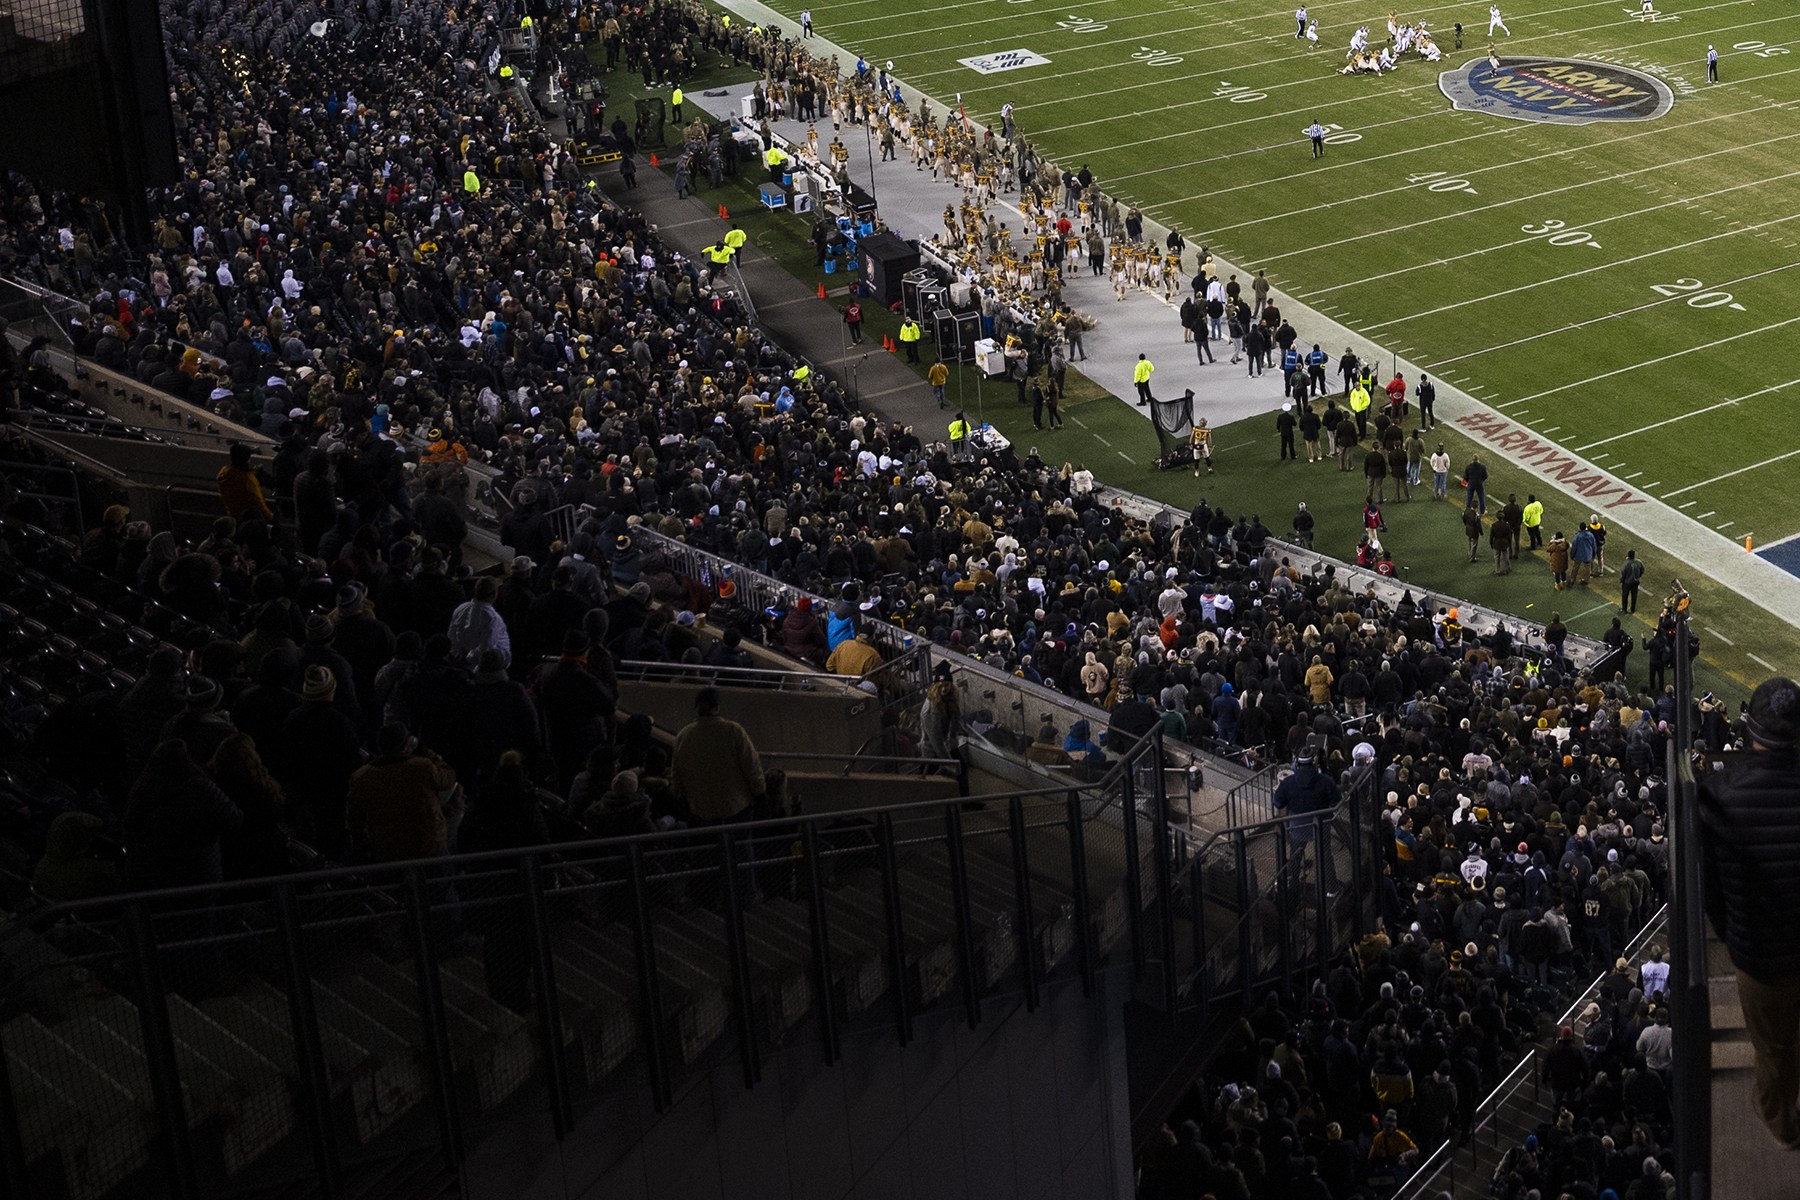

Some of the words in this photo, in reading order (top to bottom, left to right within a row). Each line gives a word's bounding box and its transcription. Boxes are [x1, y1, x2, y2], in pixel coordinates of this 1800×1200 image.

[1056, 17, 1108, 33] 20
[1131, 49, 1184, 66] 30
[1732, 40, 1790, 58] 50
[1480, 74, 1592, 110] NAVY
[1530, 64, 1651, 98] ARMY
[1212, 86, 1267, 103] 40
[1406, 170, 1470, 193] 40
[1522, 219, 1594, 246] 30
[1650, 277, 1733, 309] 20
[1195, 432, 1207, 441] 94
[1456, 412, 1646, 508] #ARMYNAVY
